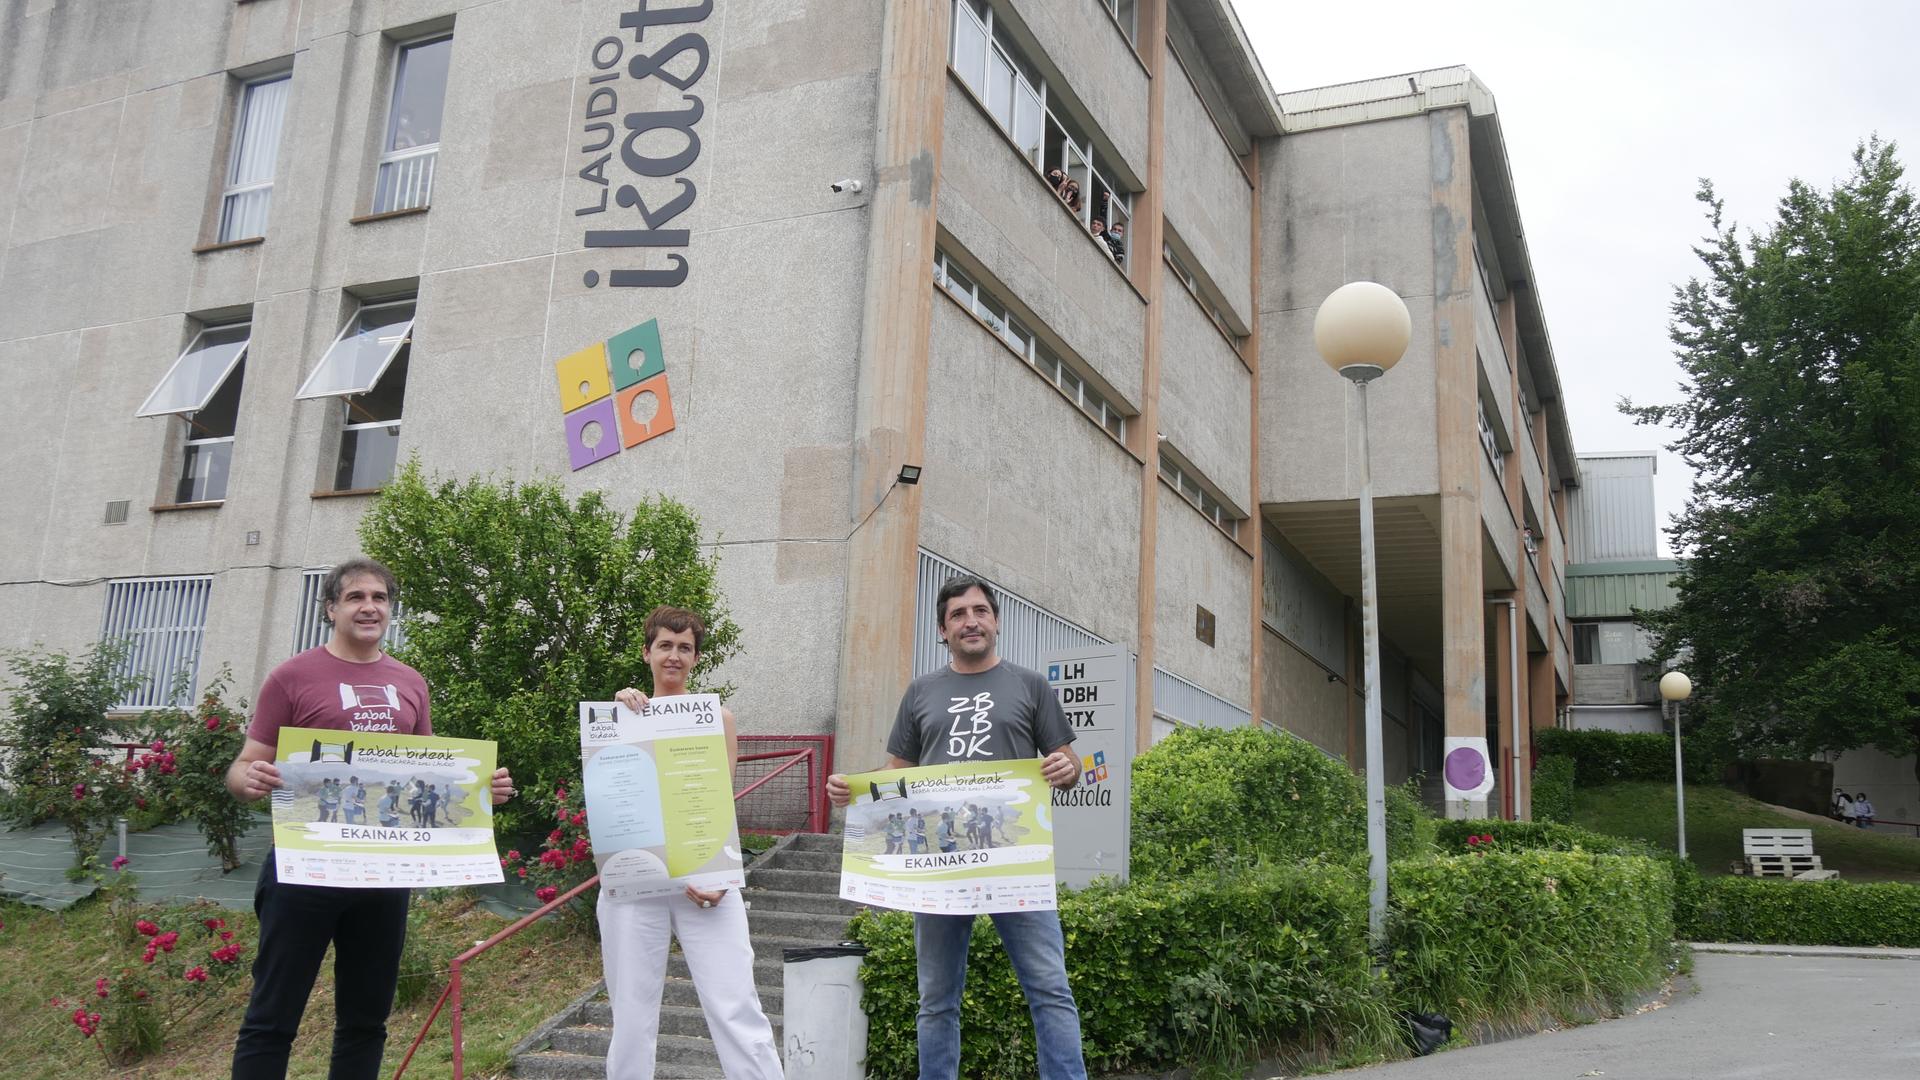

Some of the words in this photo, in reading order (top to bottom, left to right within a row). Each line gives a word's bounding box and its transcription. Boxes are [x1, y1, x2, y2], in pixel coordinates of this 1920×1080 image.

[575, 35, 624, 217] LAUDIO
[1064, 663, 1085, 680] LH
[1063, 685, 1098, 704] DBH
[353, 708, 395, 720] zabal
[642, 701, 713, 718] EKAINAK
[349, 720, 398, 732] bideak
[695, 713, 714, 725] 20
[358, 745, 400, 758] zabal
[405, 747, 455, 761] bideak
[911, 774, 950, 789] zabal
[955, 772, 1005, 786] bideak
[1051, 783, 1112, 807] kastola
[341, 828, 409, 841] EKAINAK
[413, 831, 431, 842] 20
[905, 853, 967, 869] EKAINAK
[971, 852, 989, 864] 20
